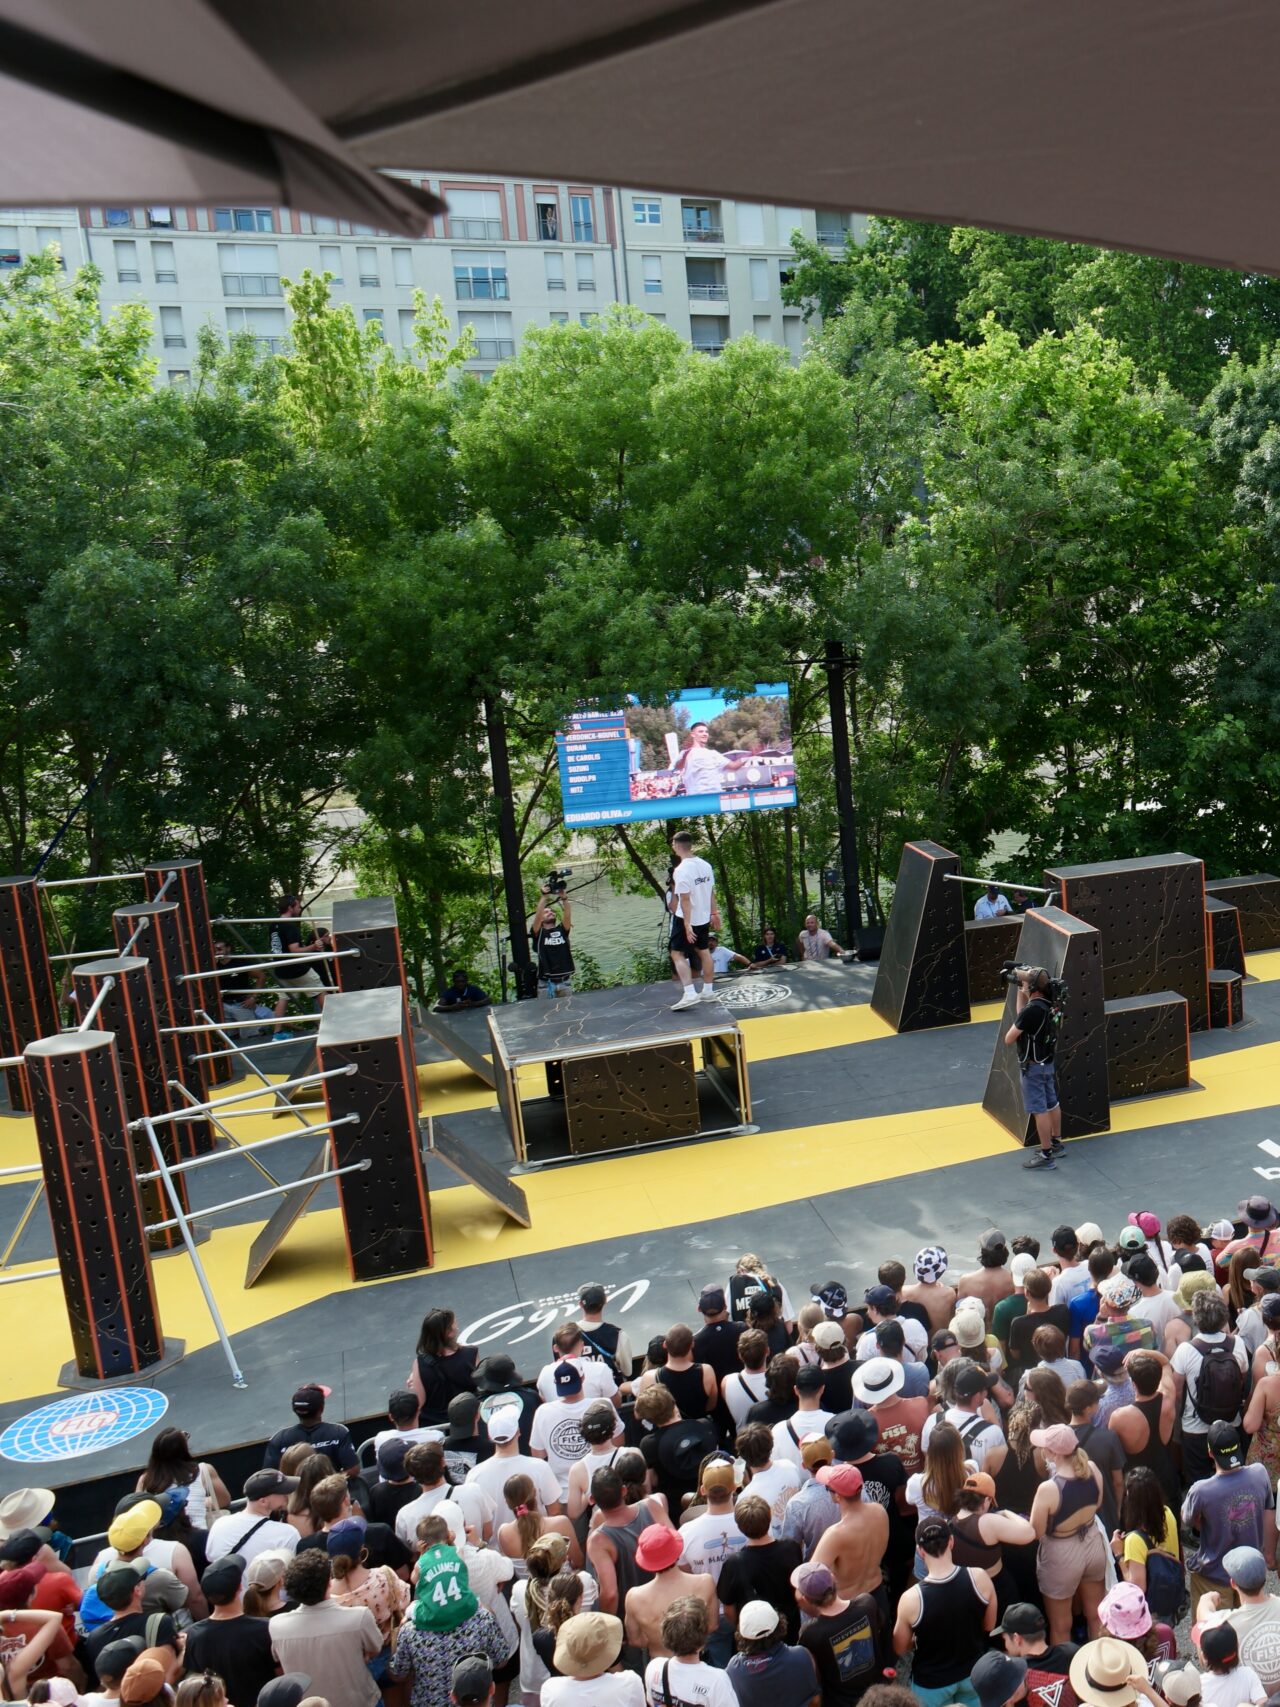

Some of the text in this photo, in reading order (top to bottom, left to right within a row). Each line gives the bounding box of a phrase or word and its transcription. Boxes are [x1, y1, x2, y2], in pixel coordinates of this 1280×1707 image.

[566, 811, 600, 822] EDUARDO
[601, 810, 622, 820] OLIVA
[560, 1375, 571, 1384] 10
[882, 1425, 908, 1440] FISE
[562, 1435, 584, 1444] FISE
[432, 1576, 462, 1607] 44
